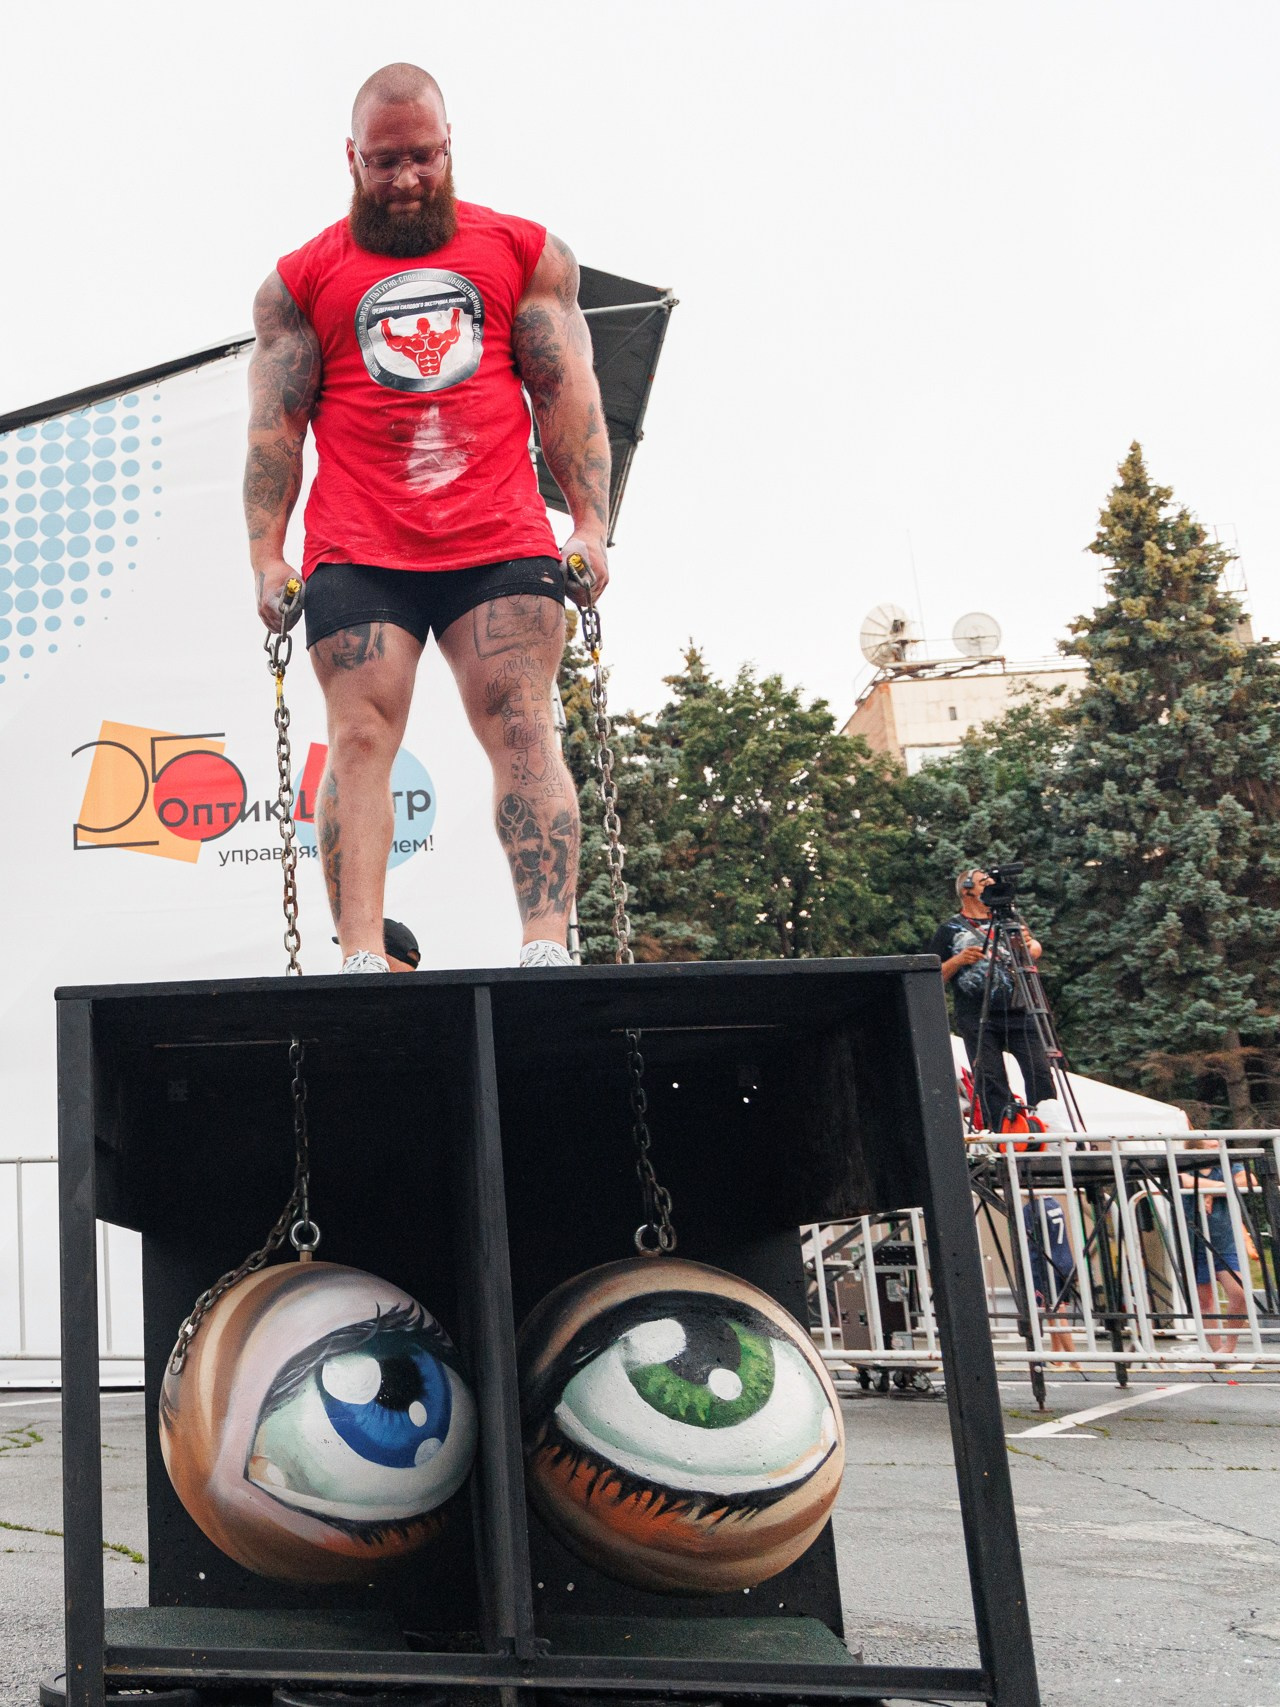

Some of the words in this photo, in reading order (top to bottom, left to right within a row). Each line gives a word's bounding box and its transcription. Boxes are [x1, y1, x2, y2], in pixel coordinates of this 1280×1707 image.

[447, 276, 481, 319] ОБЩЕСТВЕННАЯ
[72, 733, 247, 850] 25
[218, 845, 319, 867] управяя
[1052, 1217, 1064, 1245] 7
